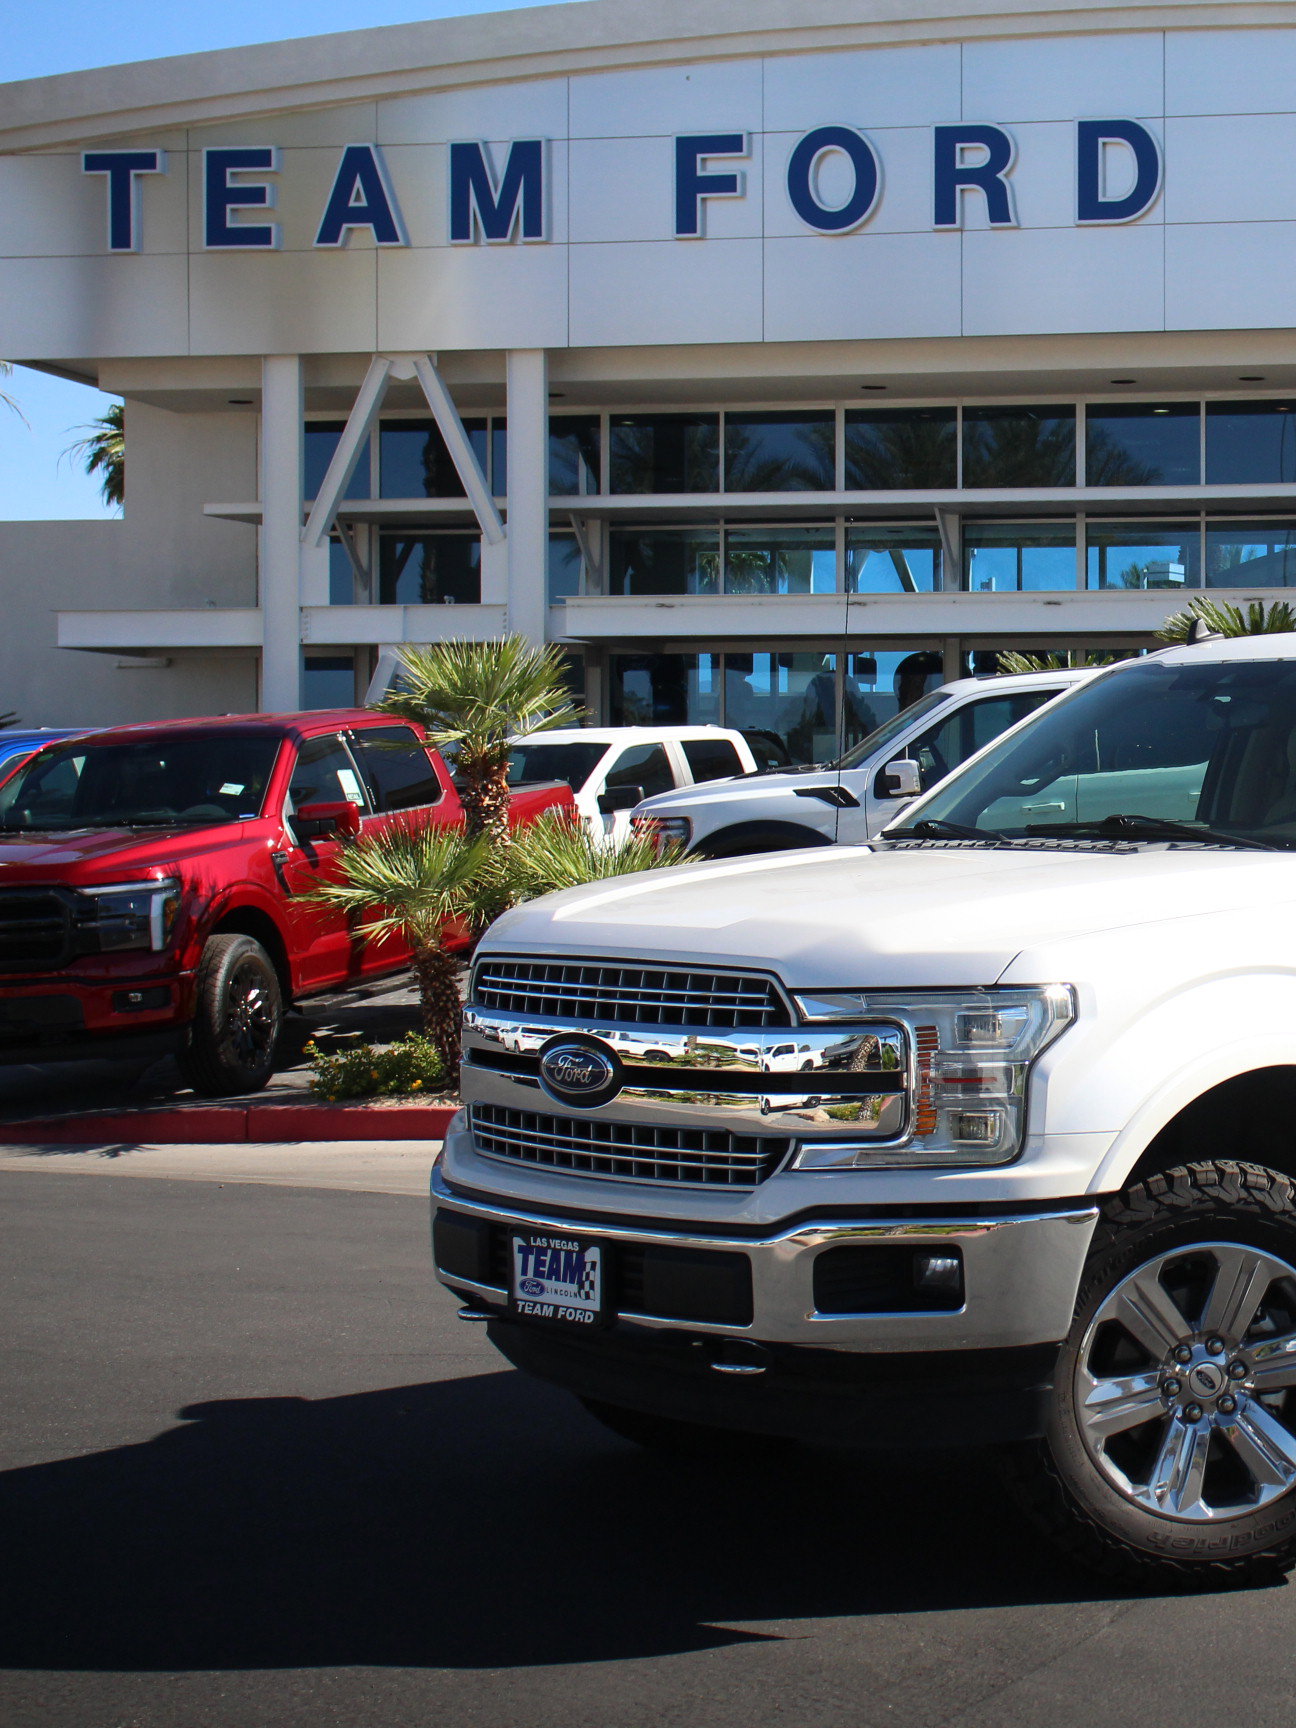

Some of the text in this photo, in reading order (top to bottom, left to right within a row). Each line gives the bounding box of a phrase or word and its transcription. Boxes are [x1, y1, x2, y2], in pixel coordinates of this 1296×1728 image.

[80, 116, 1165, 254] TEAM FORD
[554, 1054, 594, 1084] Ford
[530, 1236, 580, 1252] LAS VEGAS
[517, 1244, 586, 1286] TEAM
[546, 1287, 579, 1299] LINCOLN
[516, 1300, 595, 1323] TEAM FORD
